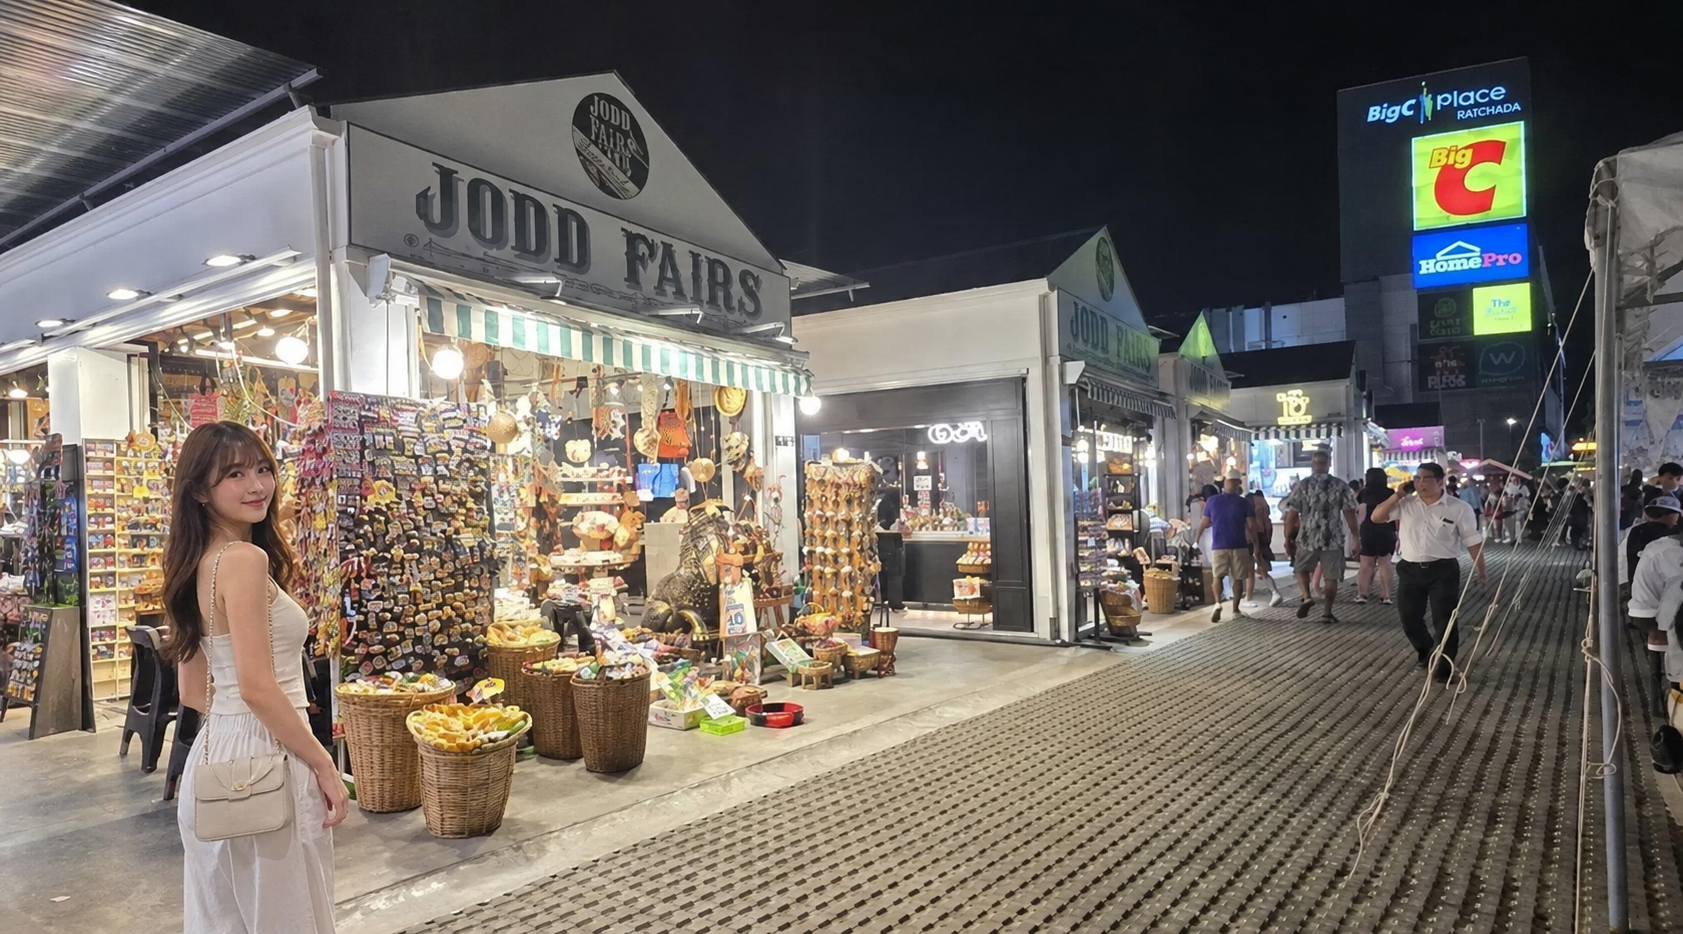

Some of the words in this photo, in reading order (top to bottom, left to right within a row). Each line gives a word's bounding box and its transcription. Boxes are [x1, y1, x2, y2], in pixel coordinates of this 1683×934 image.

[589, 94, 631, 131] JODD
[1366, 98, 1417, 124] BigC
[1437, 85, 1507, 110] place
[1457, 102, 1521, 120] RATCHADA
[1429, 144, 1474, 169] Big
[1434, 139, 1507, 216] C
[416, 162, 591, 275] JODD
[621, 227, 764, 320] FAIRS
[1418, 252, 1523, 275] HomePro
[1069, 300, 1110, 356] JODD
[1115, 324, 1152, 374] FAIRS
[727, 611, 745, 626] 10
